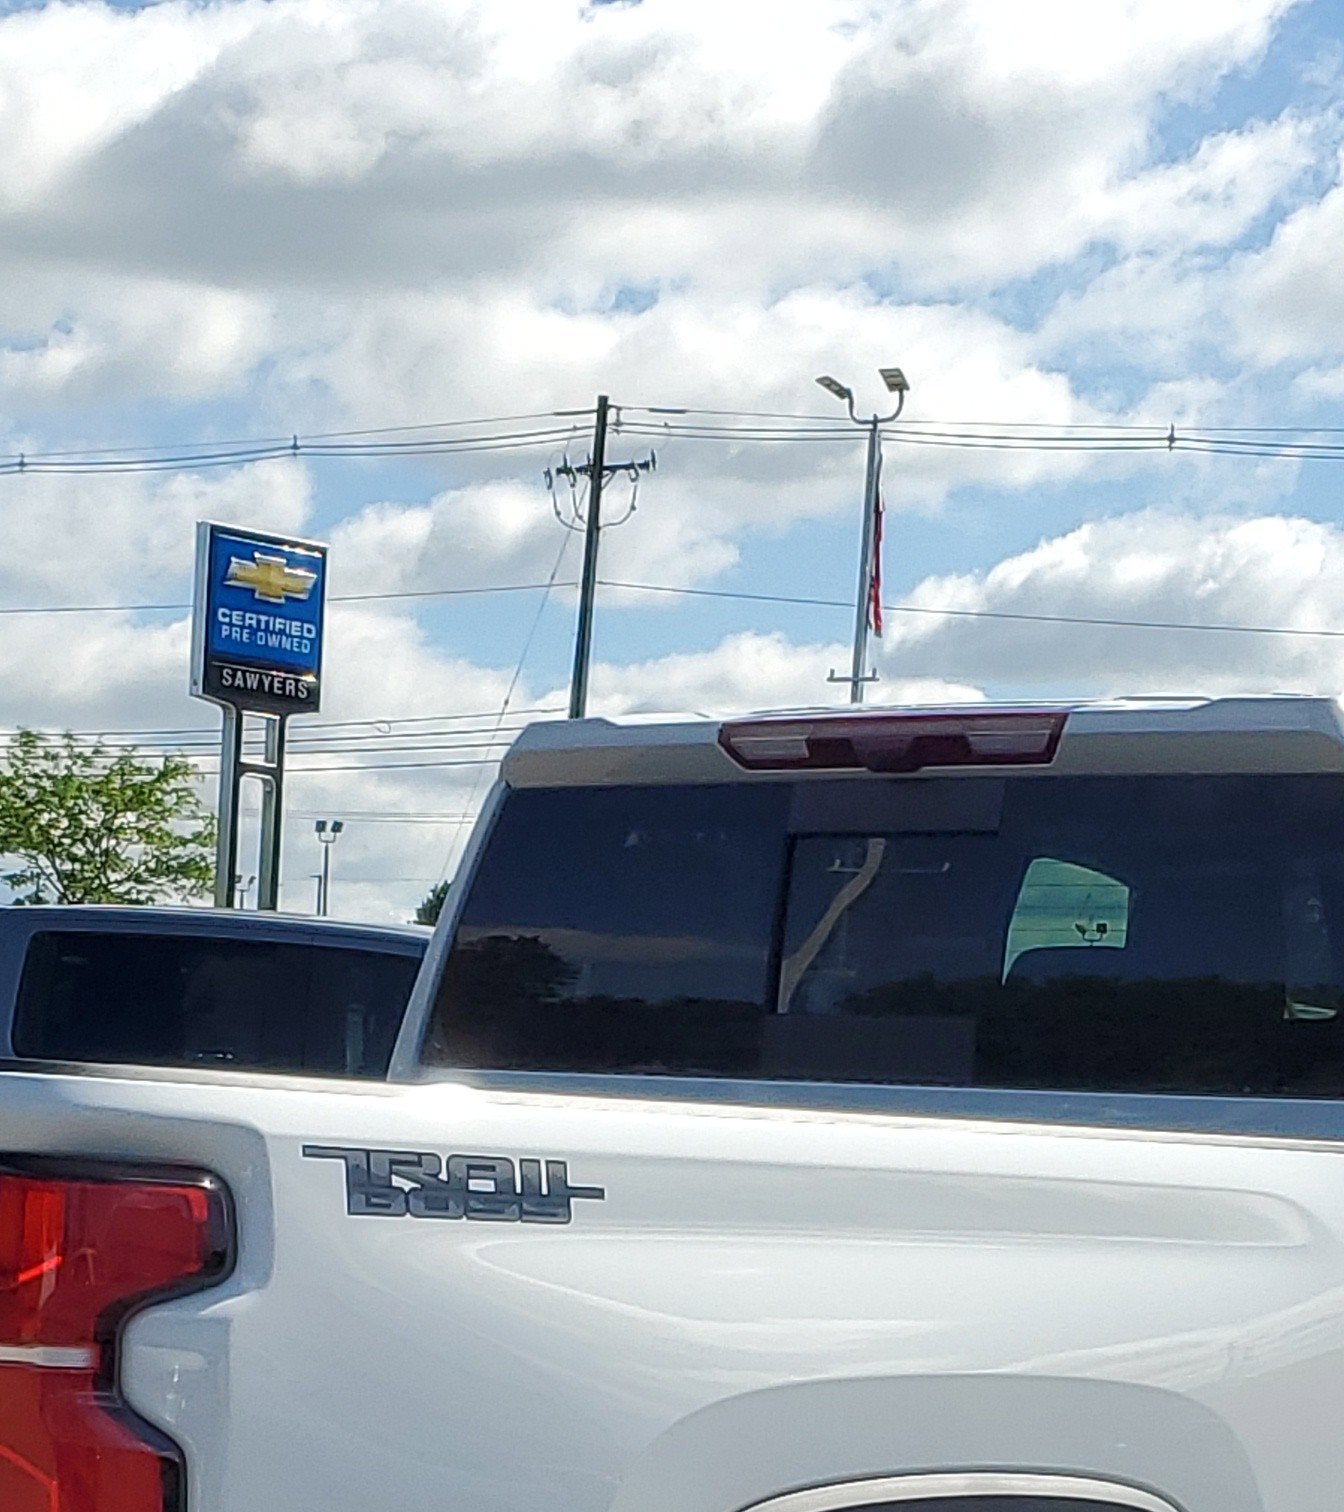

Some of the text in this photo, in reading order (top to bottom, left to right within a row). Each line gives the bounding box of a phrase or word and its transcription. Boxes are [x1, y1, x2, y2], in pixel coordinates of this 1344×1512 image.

[217, 607, 317, 639] CERTIFIED
[221, 624, 311, 654] PRE-OWNED
[222, 667, 309, 699] SAWYERS
